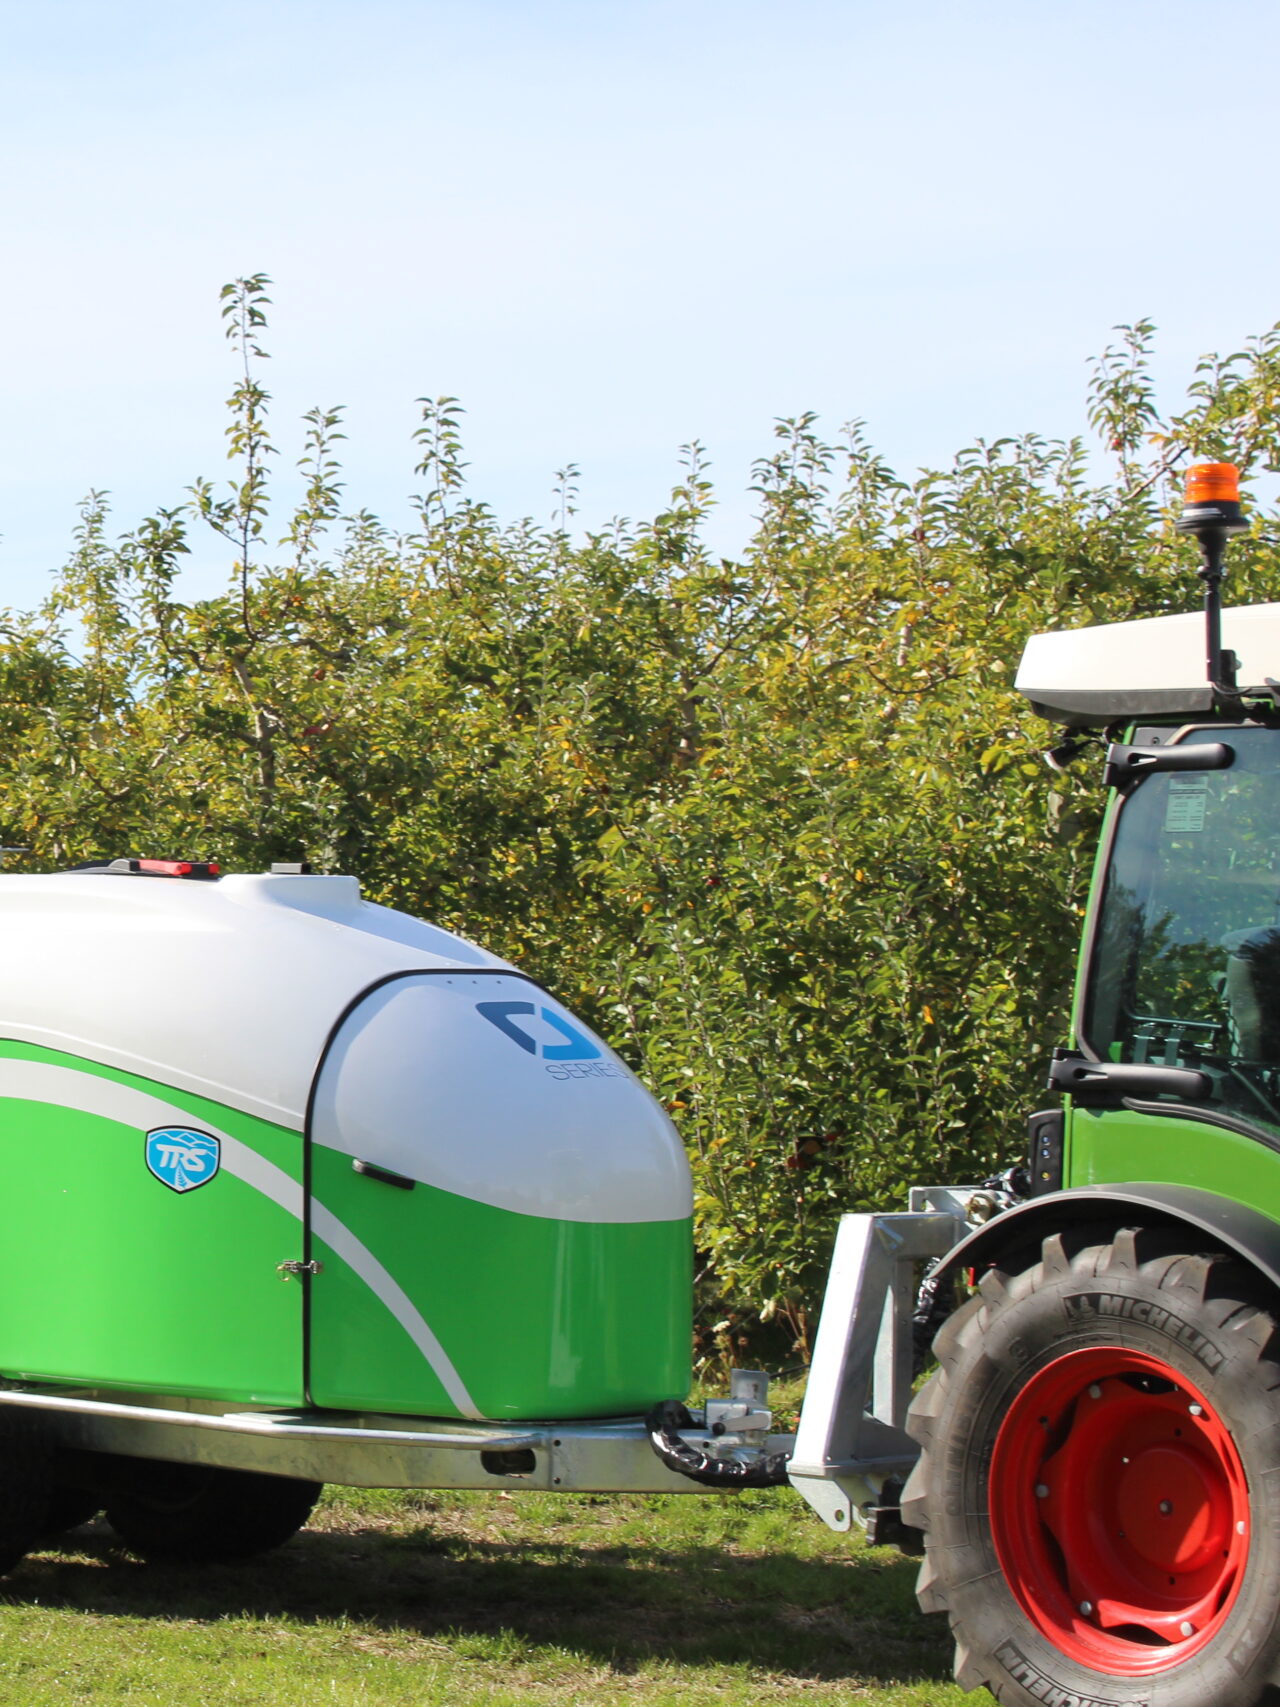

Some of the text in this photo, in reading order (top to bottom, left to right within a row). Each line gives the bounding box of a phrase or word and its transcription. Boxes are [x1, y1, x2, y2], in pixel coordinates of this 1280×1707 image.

[545, 1062, 629, 1081] SERIES
[155, 1143, 205, 1172] TRS
[1098, 1294, 1224, 1369] MICHELIN
[995, 1647, 1118, 1707] CHELIN
